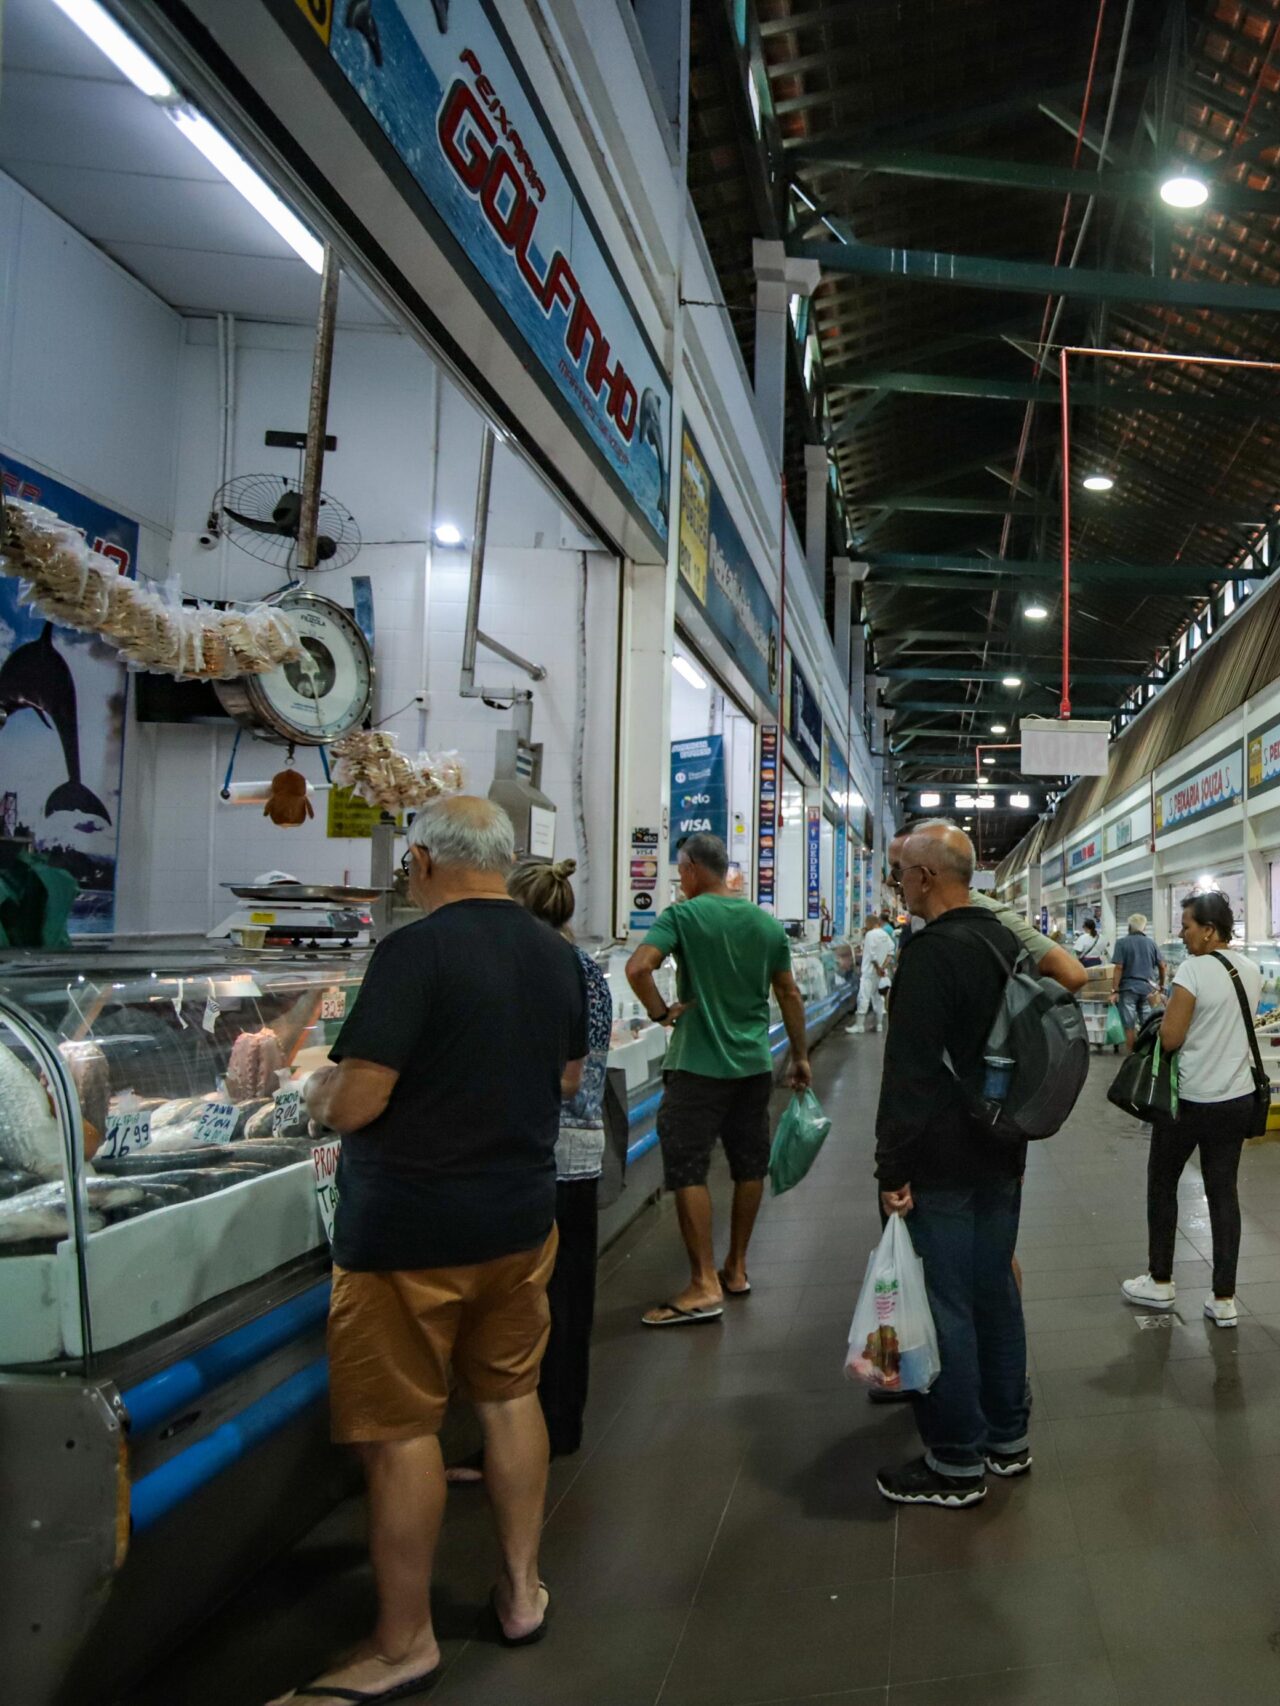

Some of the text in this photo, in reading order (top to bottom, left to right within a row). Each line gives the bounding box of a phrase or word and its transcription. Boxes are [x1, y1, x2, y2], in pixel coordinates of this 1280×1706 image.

[459, 48, 546, 202] PEIXARIA
[1173, 769, 1223, 814] PEIXARIA SOUZA
[680, 819, 712, 832] VISA
